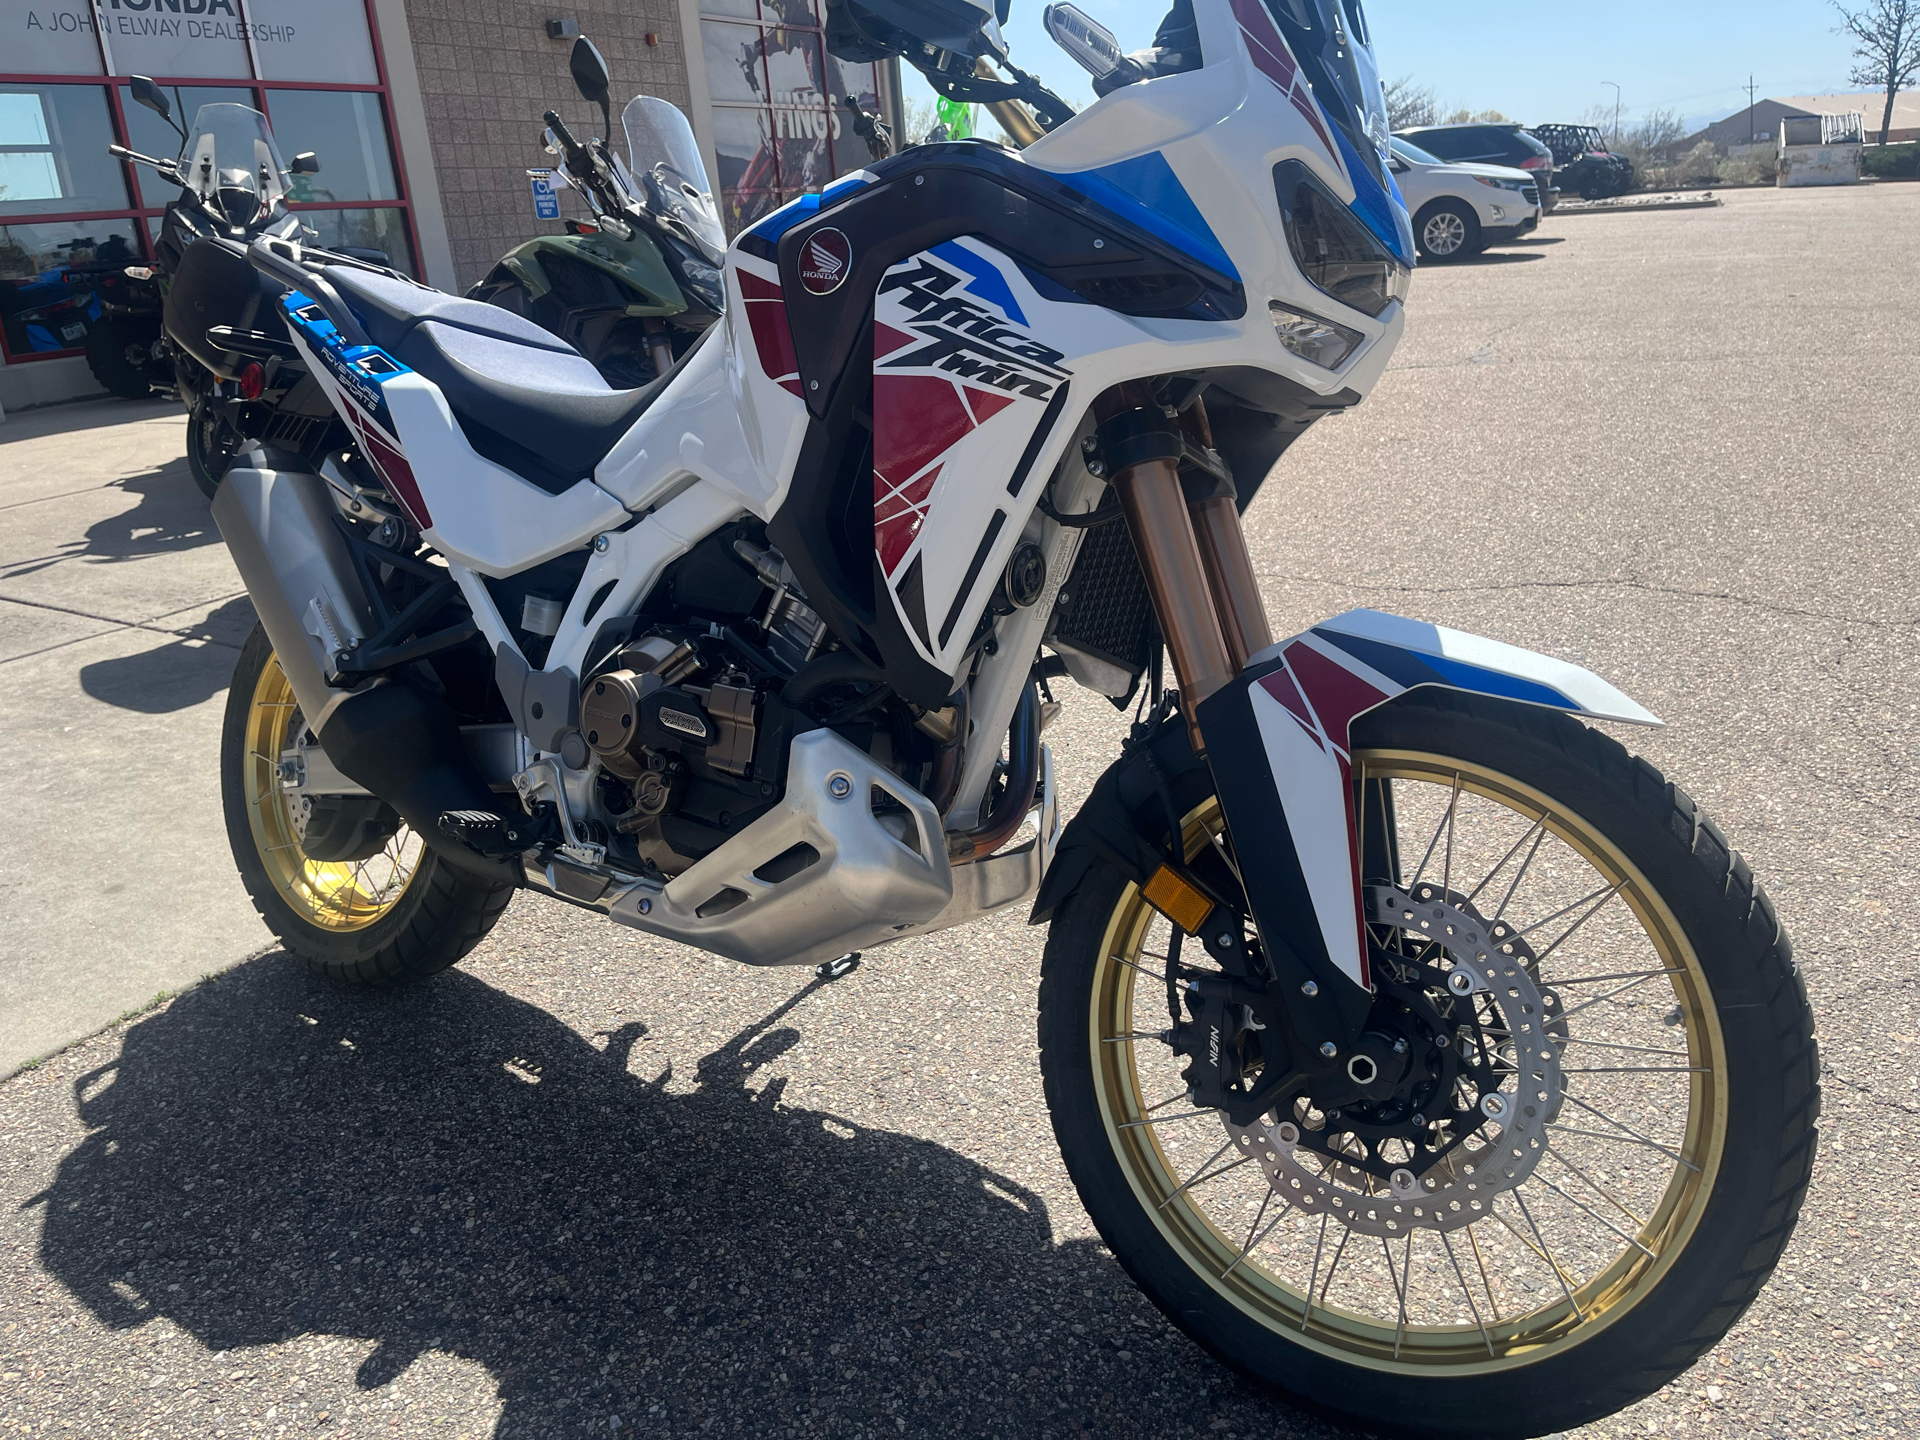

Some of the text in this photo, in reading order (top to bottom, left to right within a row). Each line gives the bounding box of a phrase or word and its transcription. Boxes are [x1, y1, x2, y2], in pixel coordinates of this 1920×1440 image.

[26, 10, 296, 43] A JOHN ELWAY DEALERSHIP
[756, 89, 841, 140] WINGS
[803, 270, 840, 281] HONDA
[878, 256, 1075, 377] Africa
[321, 346, 381, 404] ADVENTURE
[876, 324, 1067, 403] Twin
[338, 373, 377, 412] SPORTS
[1209, 1024, 1220, 1068] NISSIN
